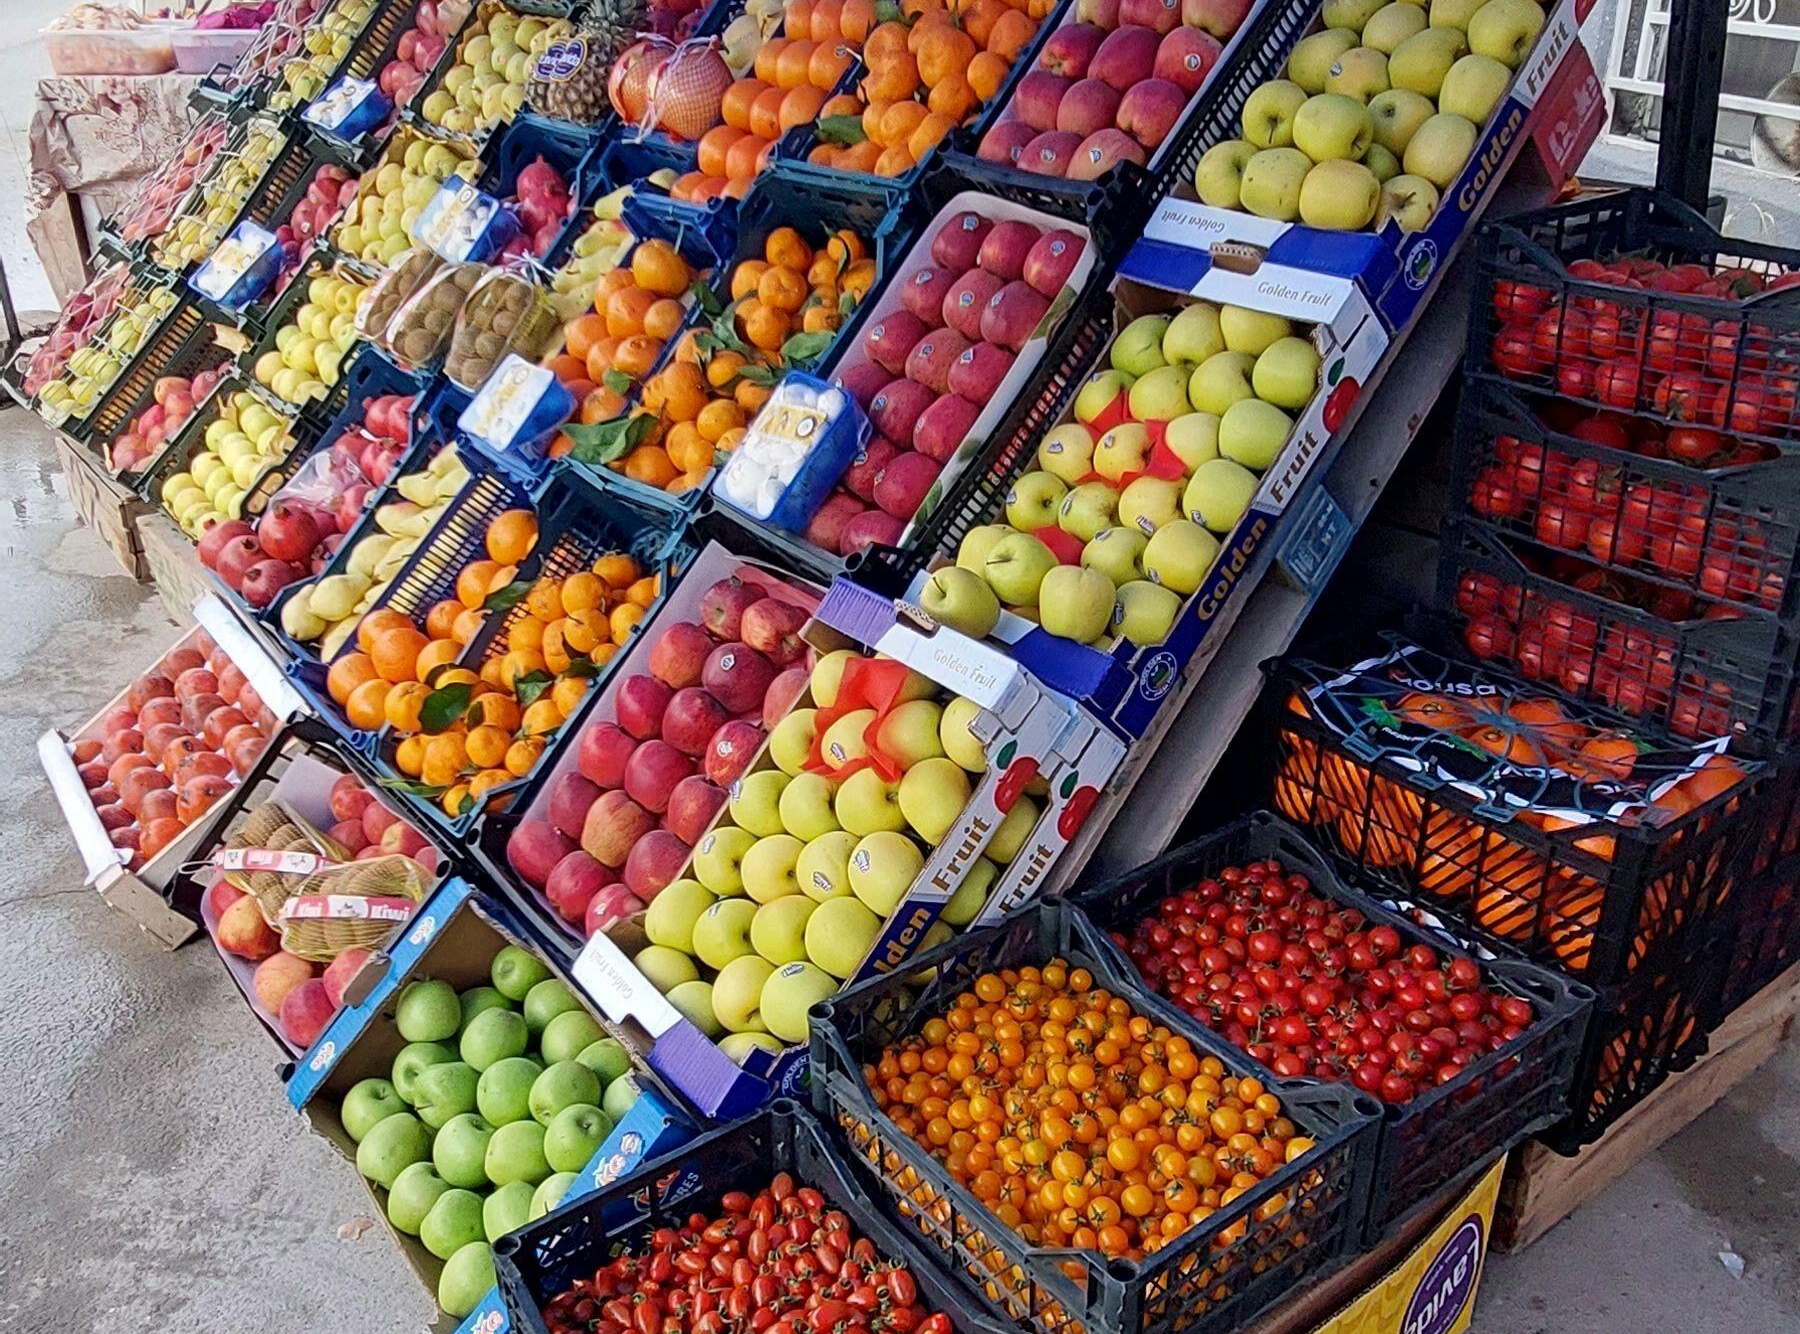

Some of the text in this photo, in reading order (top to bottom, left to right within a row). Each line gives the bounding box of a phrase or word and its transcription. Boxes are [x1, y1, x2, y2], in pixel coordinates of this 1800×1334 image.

[1458, 21, 1570, 212] Golden Fruit
[1161, 209, 1226, 234] Golden Fruit
[1257, 280, 1333, 307] Golden Fruit
[1197, 518, 1268, 620] Golden
[1270, 430, 1319, 504] Fruit
[932, 648, 998, 689] Golden Fruit
[873, 908, 932, 973] lden
[931, 815, 992, 892] Fruit
[998, 843, 1055, 915] Fruit
[371, 904, 410, 921] Kiwi
